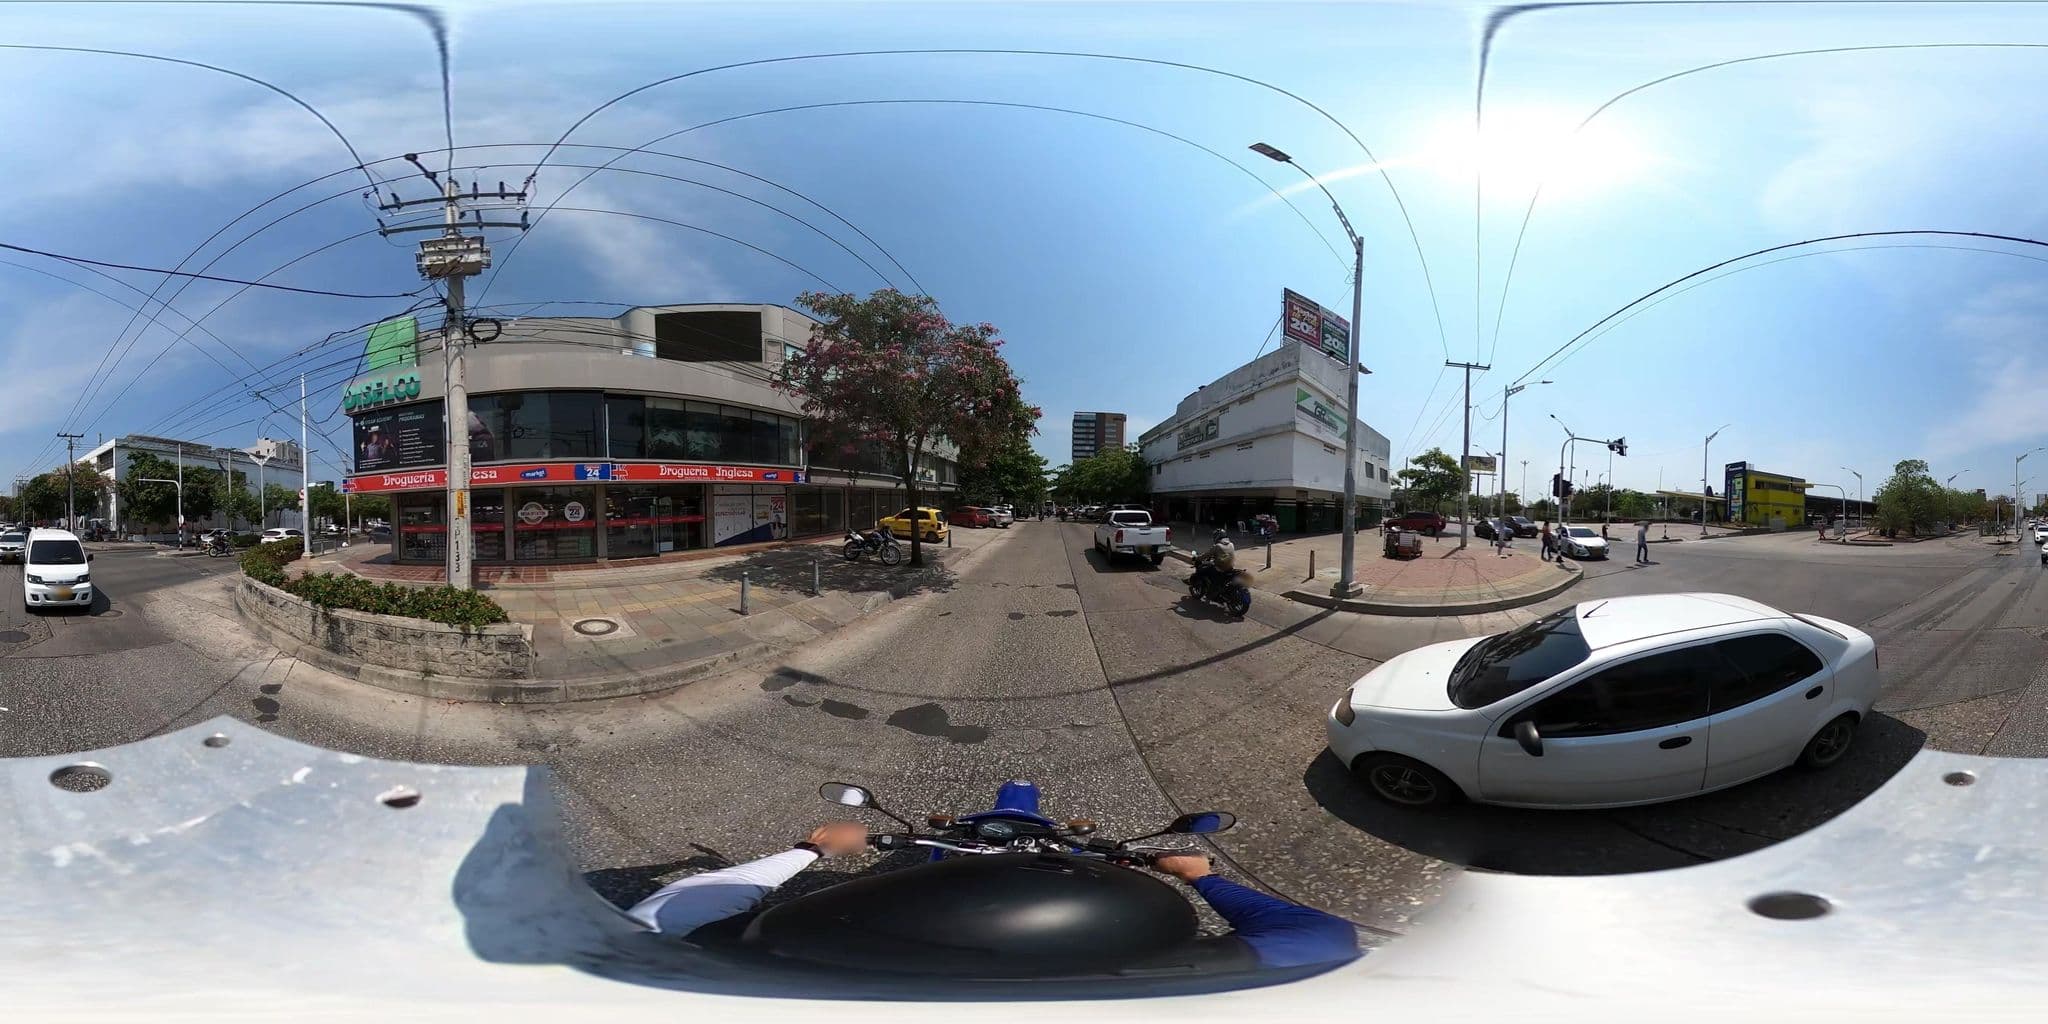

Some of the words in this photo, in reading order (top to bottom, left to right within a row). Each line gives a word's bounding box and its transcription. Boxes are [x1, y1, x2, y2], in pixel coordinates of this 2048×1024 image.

[586, 469, 599, 477] 24
[716, 466, 754, 480] Inglesa
[773, 501, 785, 511] 24
